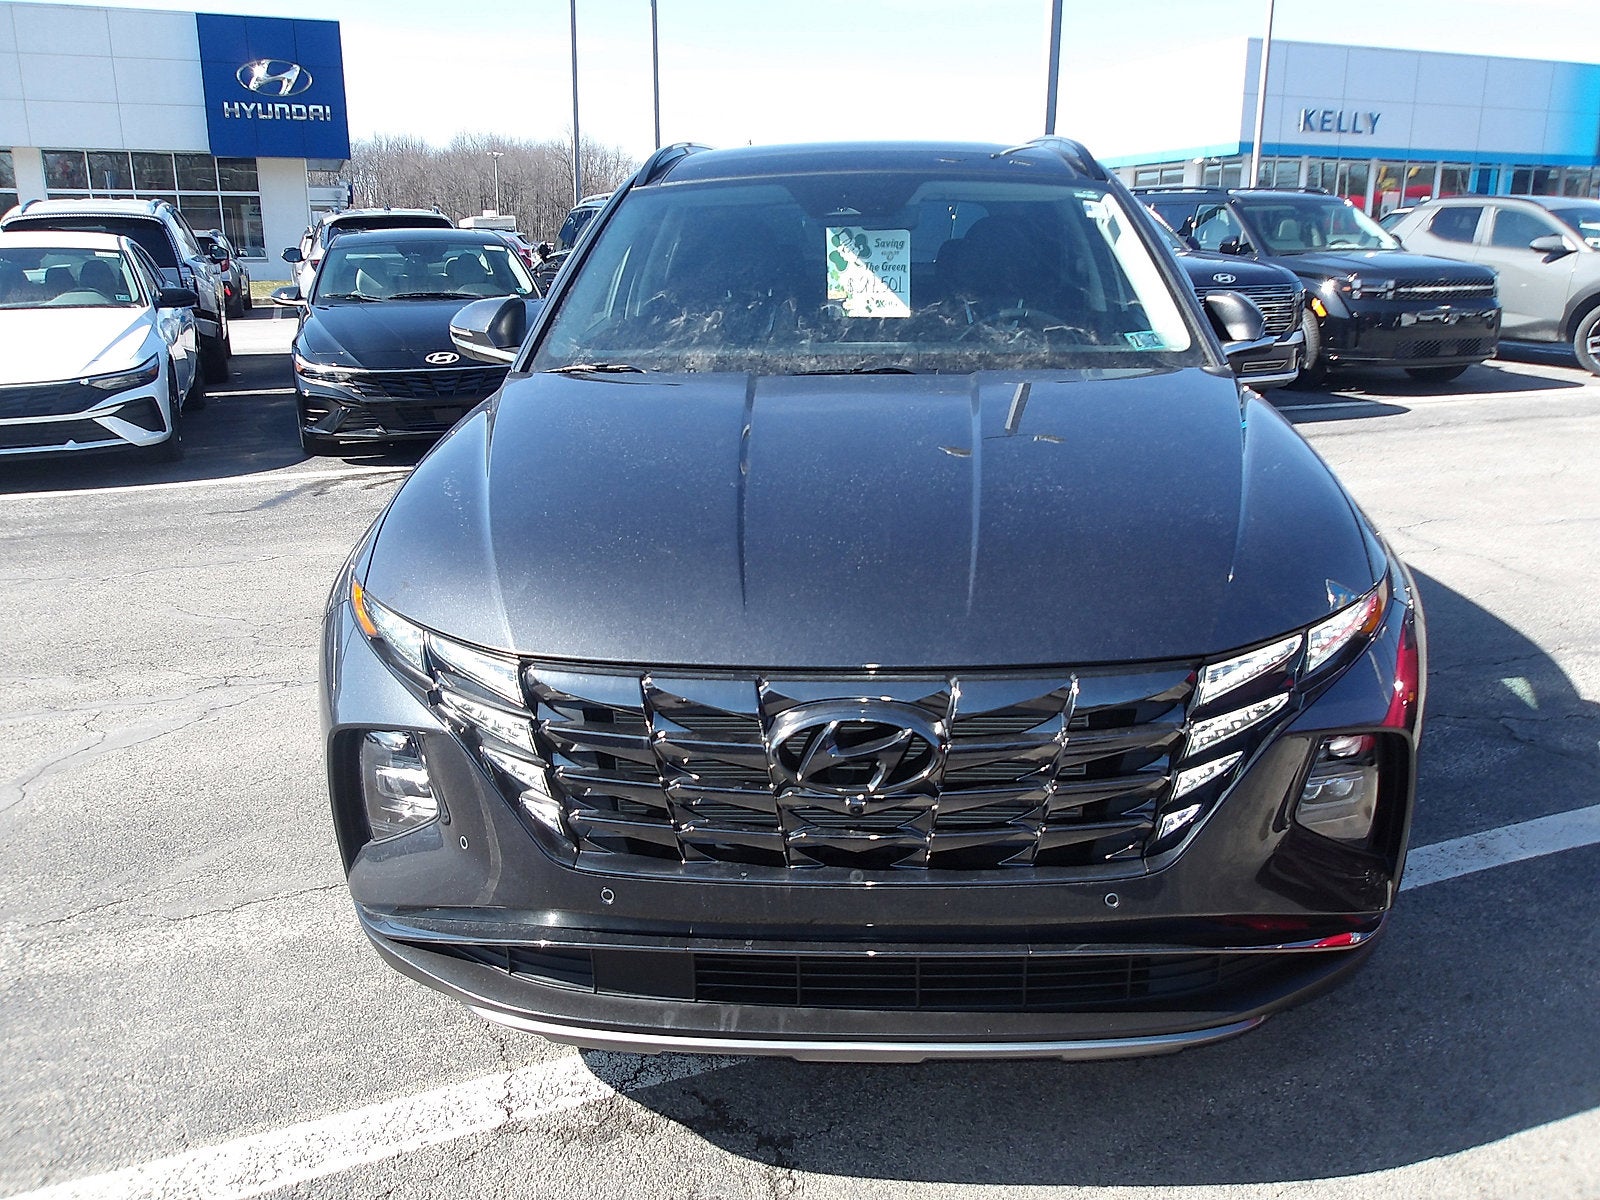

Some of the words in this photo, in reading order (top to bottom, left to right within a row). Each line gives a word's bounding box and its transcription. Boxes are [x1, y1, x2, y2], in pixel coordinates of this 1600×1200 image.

[223, 101, 331, 121] HYUNDAI
[1299, 108, 1381, 135] KELLY
[874, 238, 905, 250] Saving
[865, 261, 880, 274] The
[881, 261, 907, 273] Green
